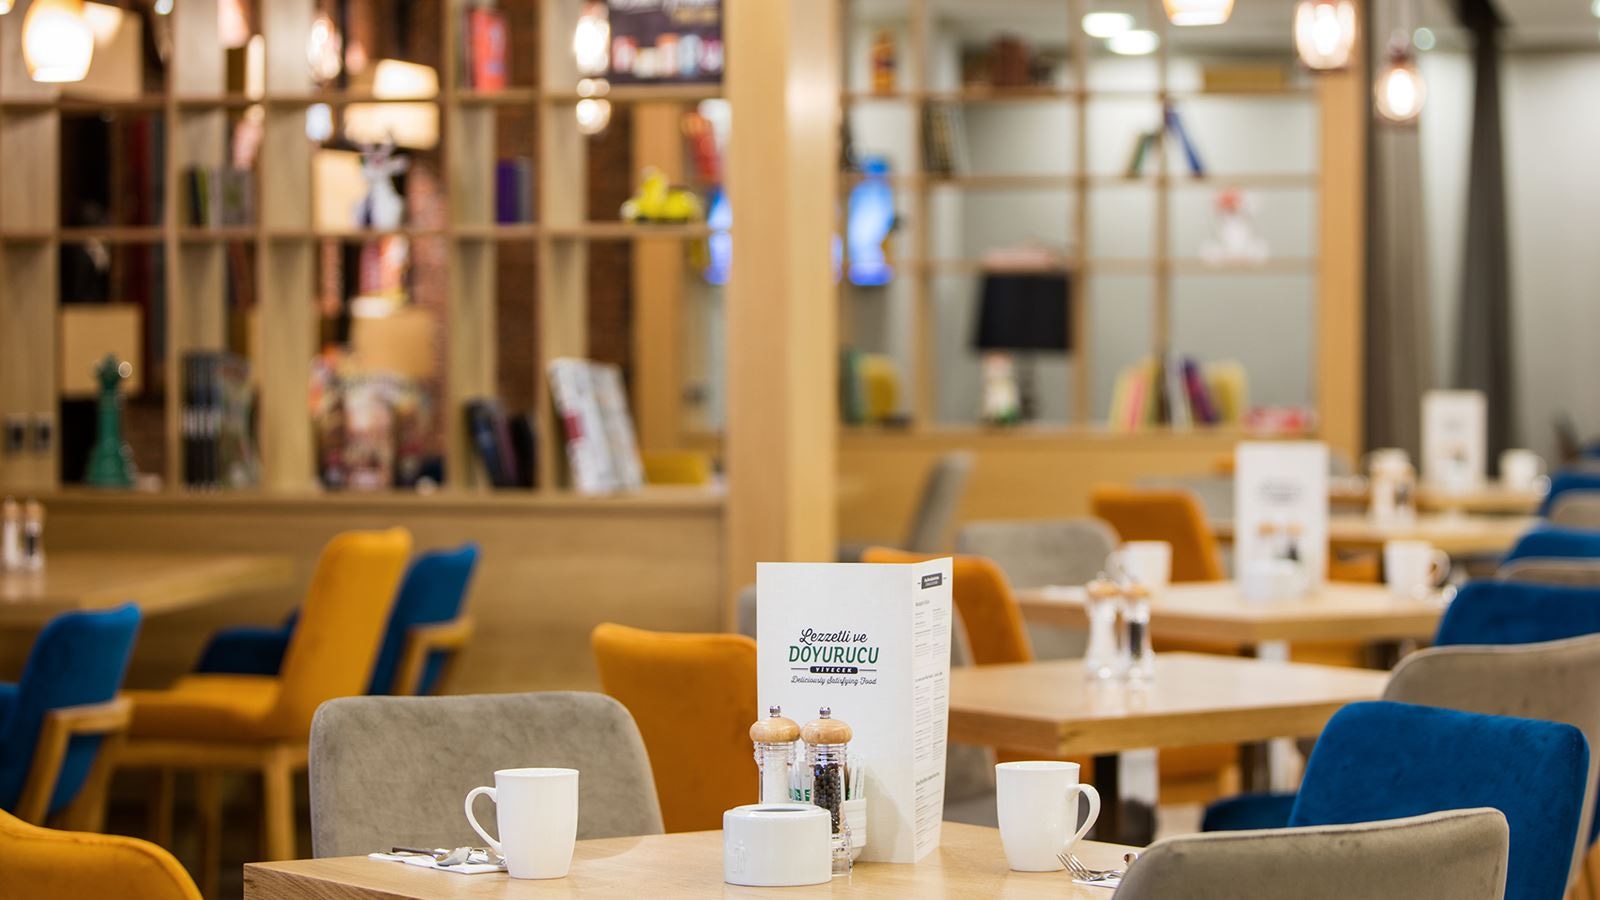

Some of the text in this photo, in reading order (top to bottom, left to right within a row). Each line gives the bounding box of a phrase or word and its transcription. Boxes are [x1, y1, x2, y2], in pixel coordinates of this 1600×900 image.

[799, 628, 868, 645] Lezzetli ve
[789, 646, 879, 663] DOYURUCU
[790, 675, 877, 686] Deliciously Satisfying Food
